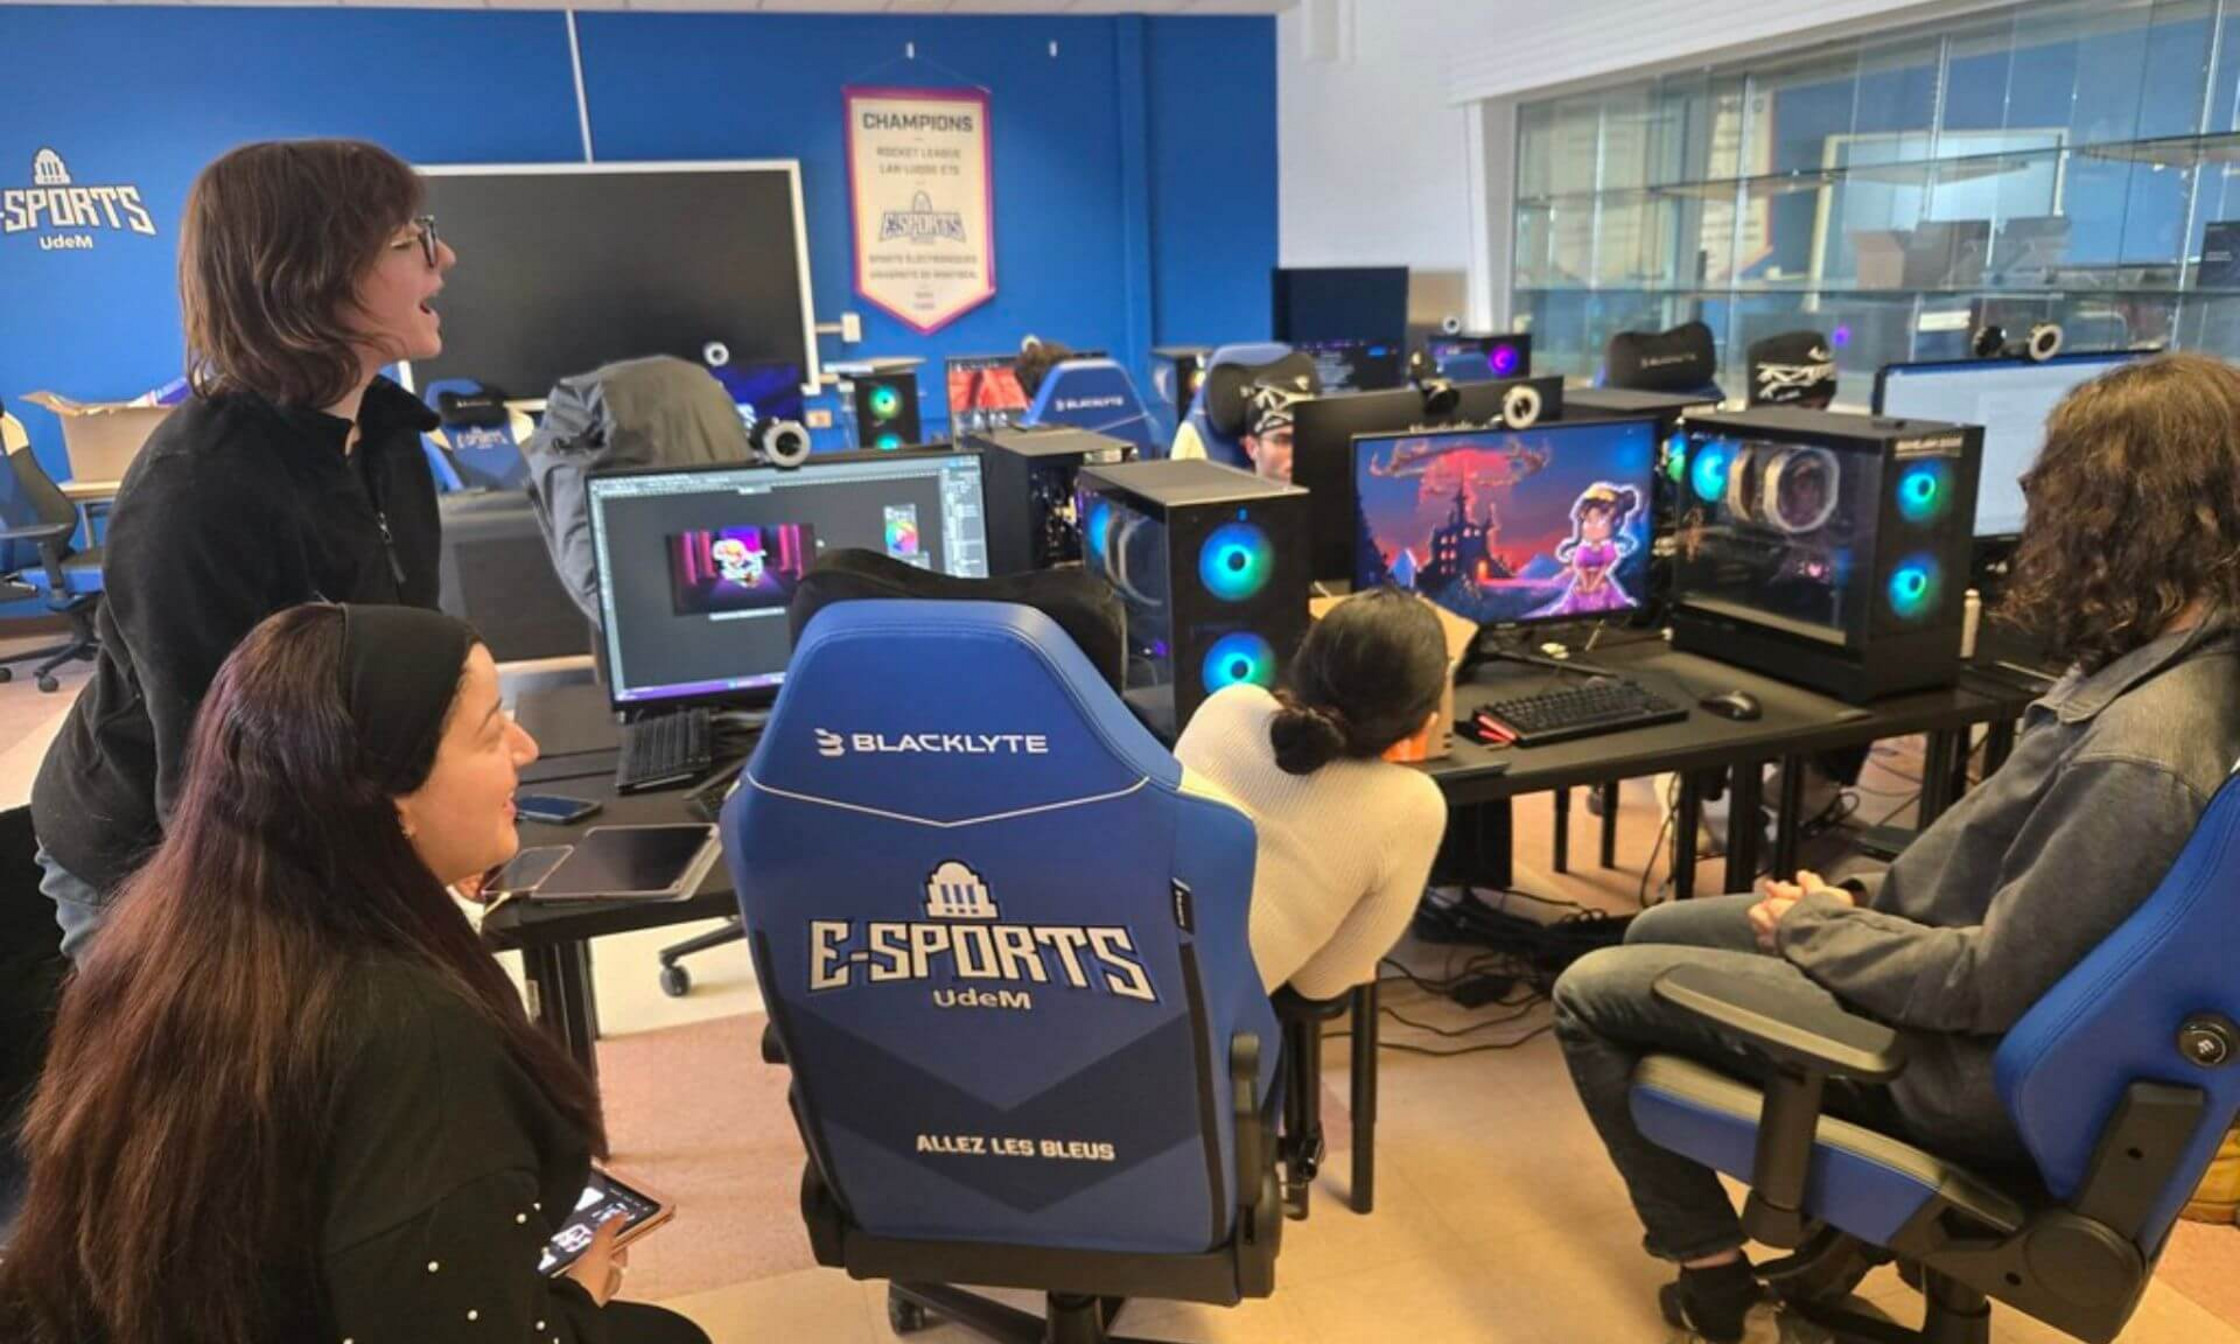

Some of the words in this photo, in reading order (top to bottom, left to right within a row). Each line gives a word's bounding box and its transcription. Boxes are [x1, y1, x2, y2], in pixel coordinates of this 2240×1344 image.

[863, 112, 973, 132] CHAMPIONS
[39, 234, 94, 250] UdeM
[852, 733, 1049, 753] BLACKLYTE
[809, 920, 1159, 1002] E-SPORTS
[932, 988, 1032, 1010] UdeM
[917, 1135, 987, 1154] ALLEZ
[991, 1138, 1035, 1156] LES
[1040, 1140, 1115, 1161] BLEUS
